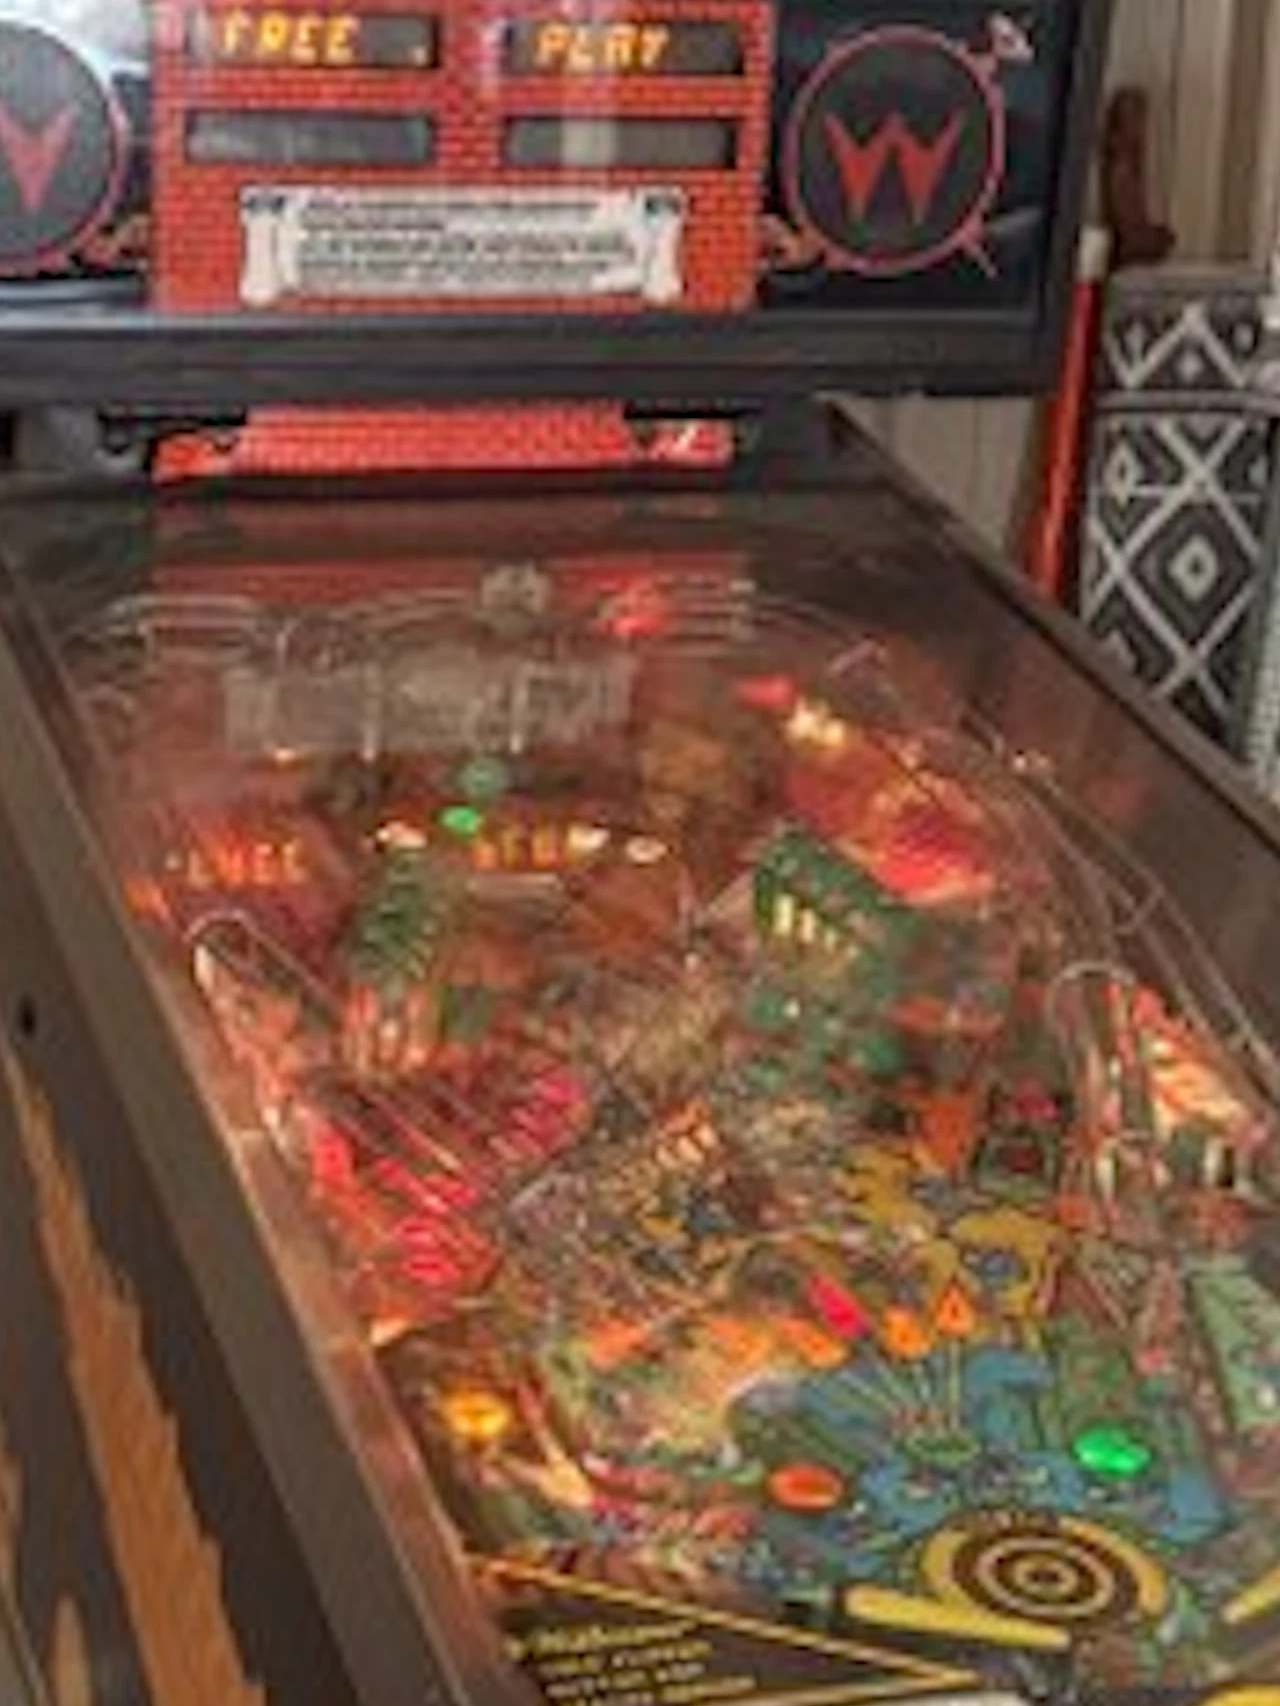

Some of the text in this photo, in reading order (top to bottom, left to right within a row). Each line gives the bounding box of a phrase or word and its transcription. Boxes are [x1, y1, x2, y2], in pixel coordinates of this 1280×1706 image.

[222, 11, 672, 73] FREE PLAY
[824, 108, 966, 227] W
